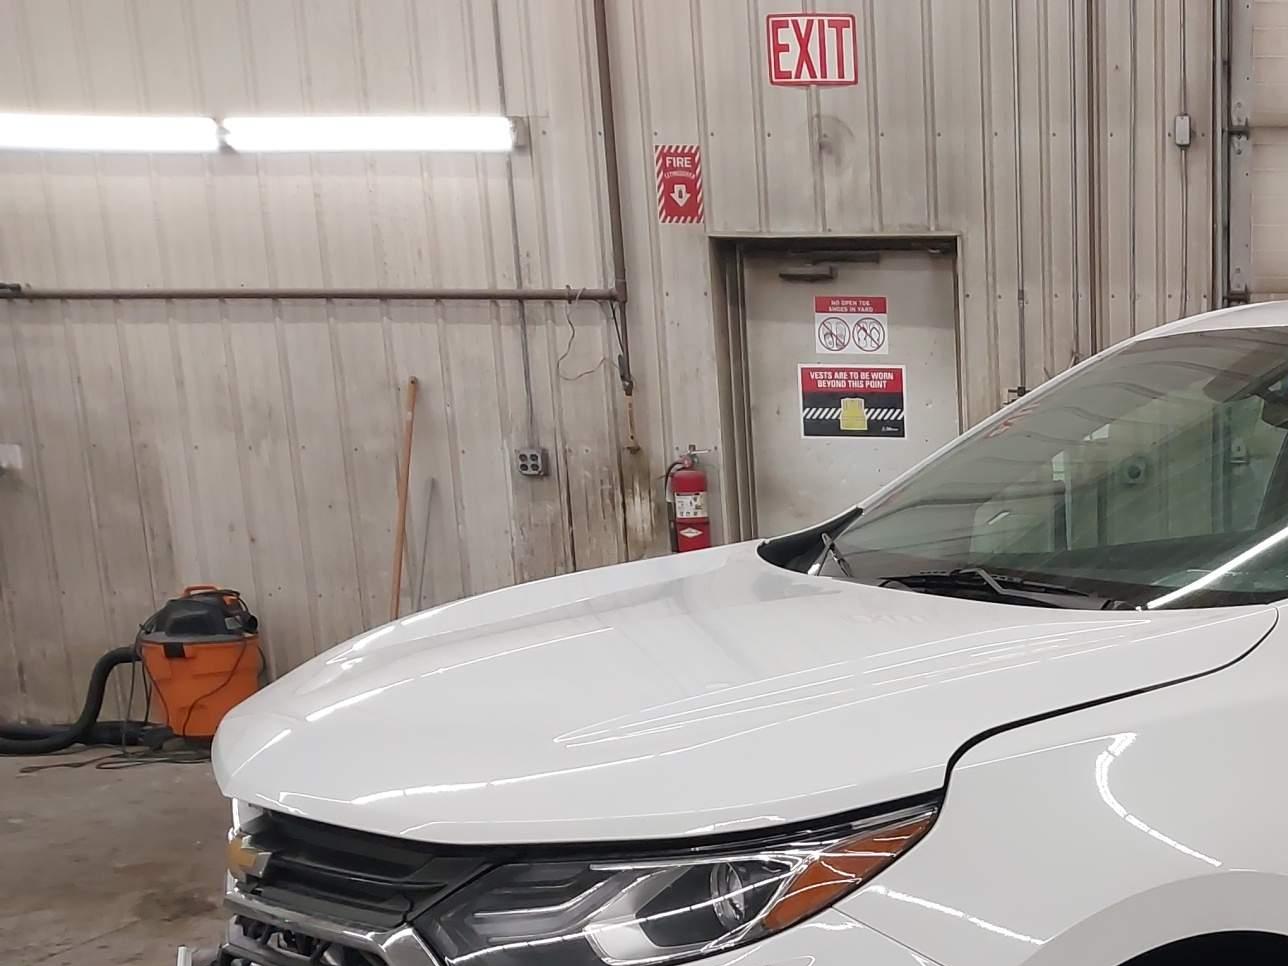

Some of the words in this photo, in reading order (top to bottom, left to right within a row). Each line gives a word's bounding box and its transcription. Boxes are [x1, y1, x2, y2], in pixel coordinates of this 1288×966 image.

[771, 19, 851, 79] EXIT
[665, 156, 693, 168] FIRE
[810, 371, 833, 380] VESTS
[834, 372, 849, 380] ARE
[850, 372, 860, 380] TO
[861, 372, 870, 380] BE
[871, 372, 894, 380] WORN
[817, 380, 847, 388] BEYOND
[848, 380, 865, 388] THIS
[866, 380, 887, 388] POINT
